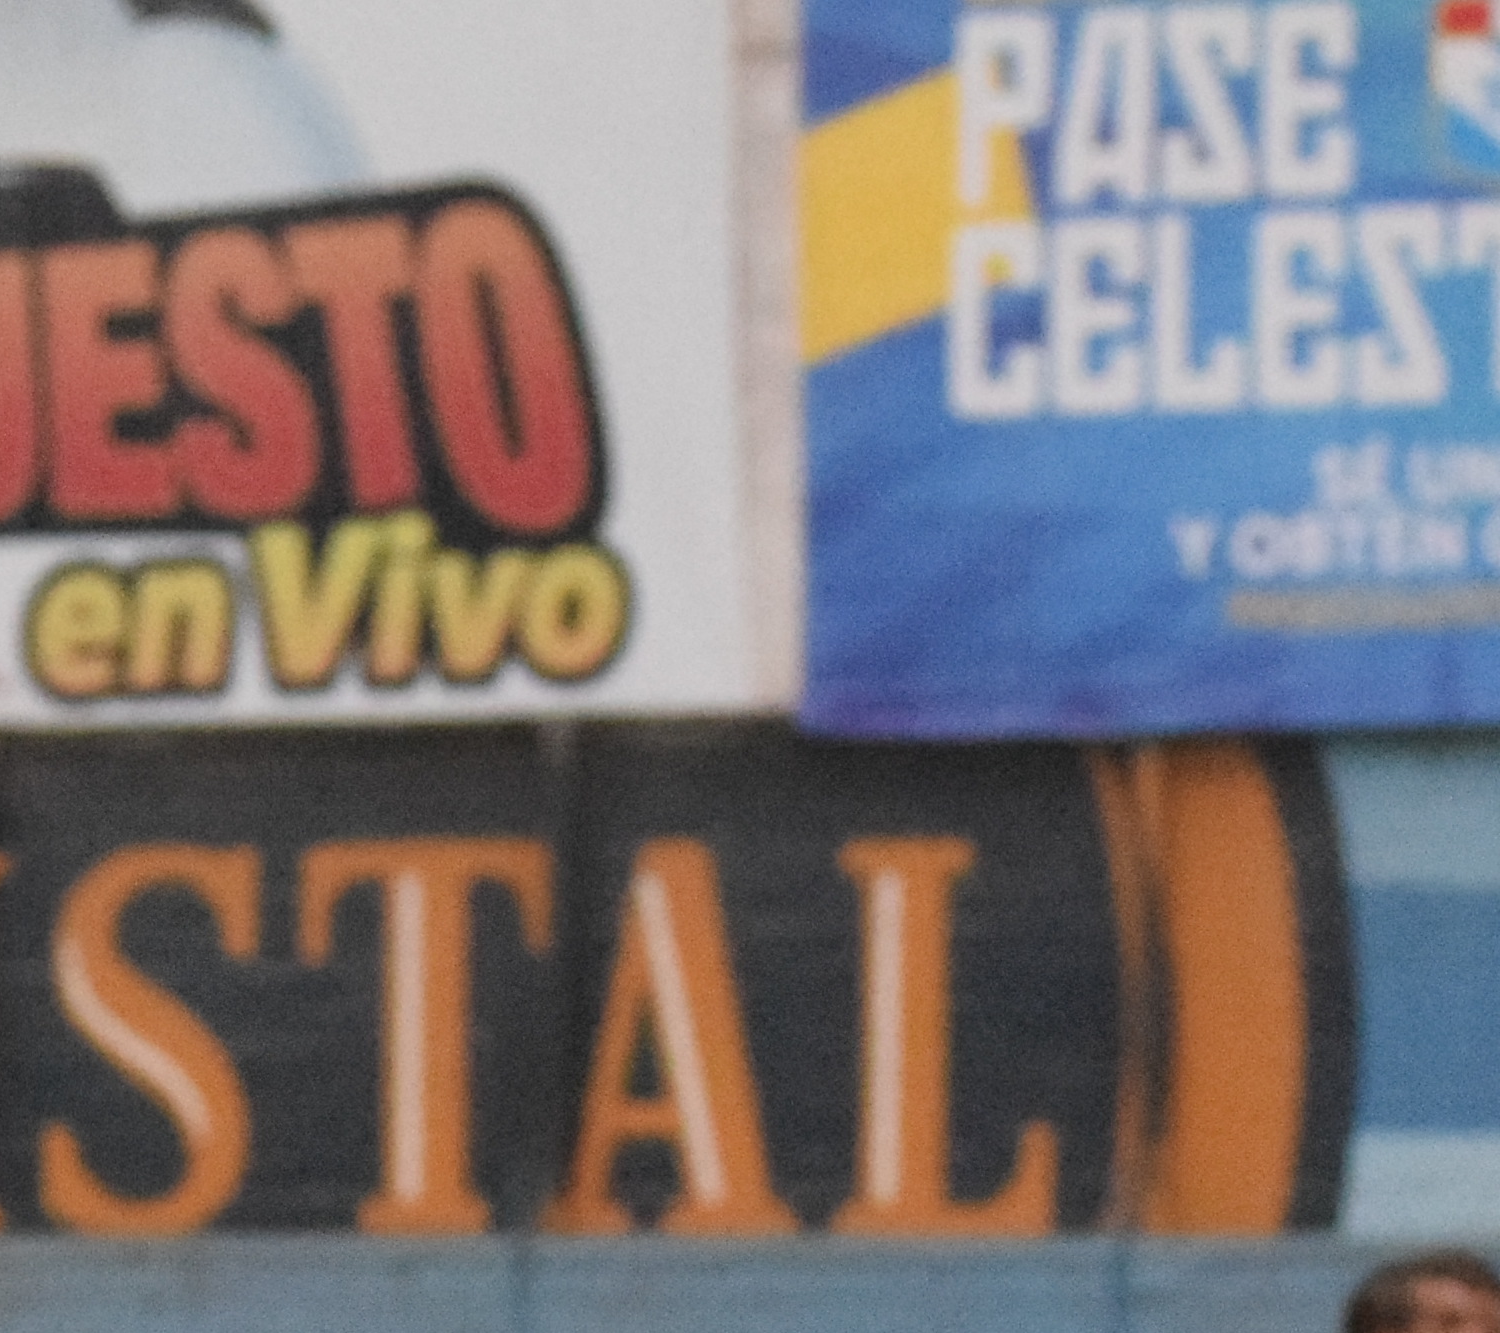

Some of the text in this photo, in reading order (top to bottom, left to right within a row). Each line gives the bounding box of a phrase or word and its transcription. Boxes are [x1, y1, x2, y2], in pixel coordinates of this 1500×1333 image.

[953, 4, 1358, 205] PASE
[30, 515, 630, 696] en Vivo
